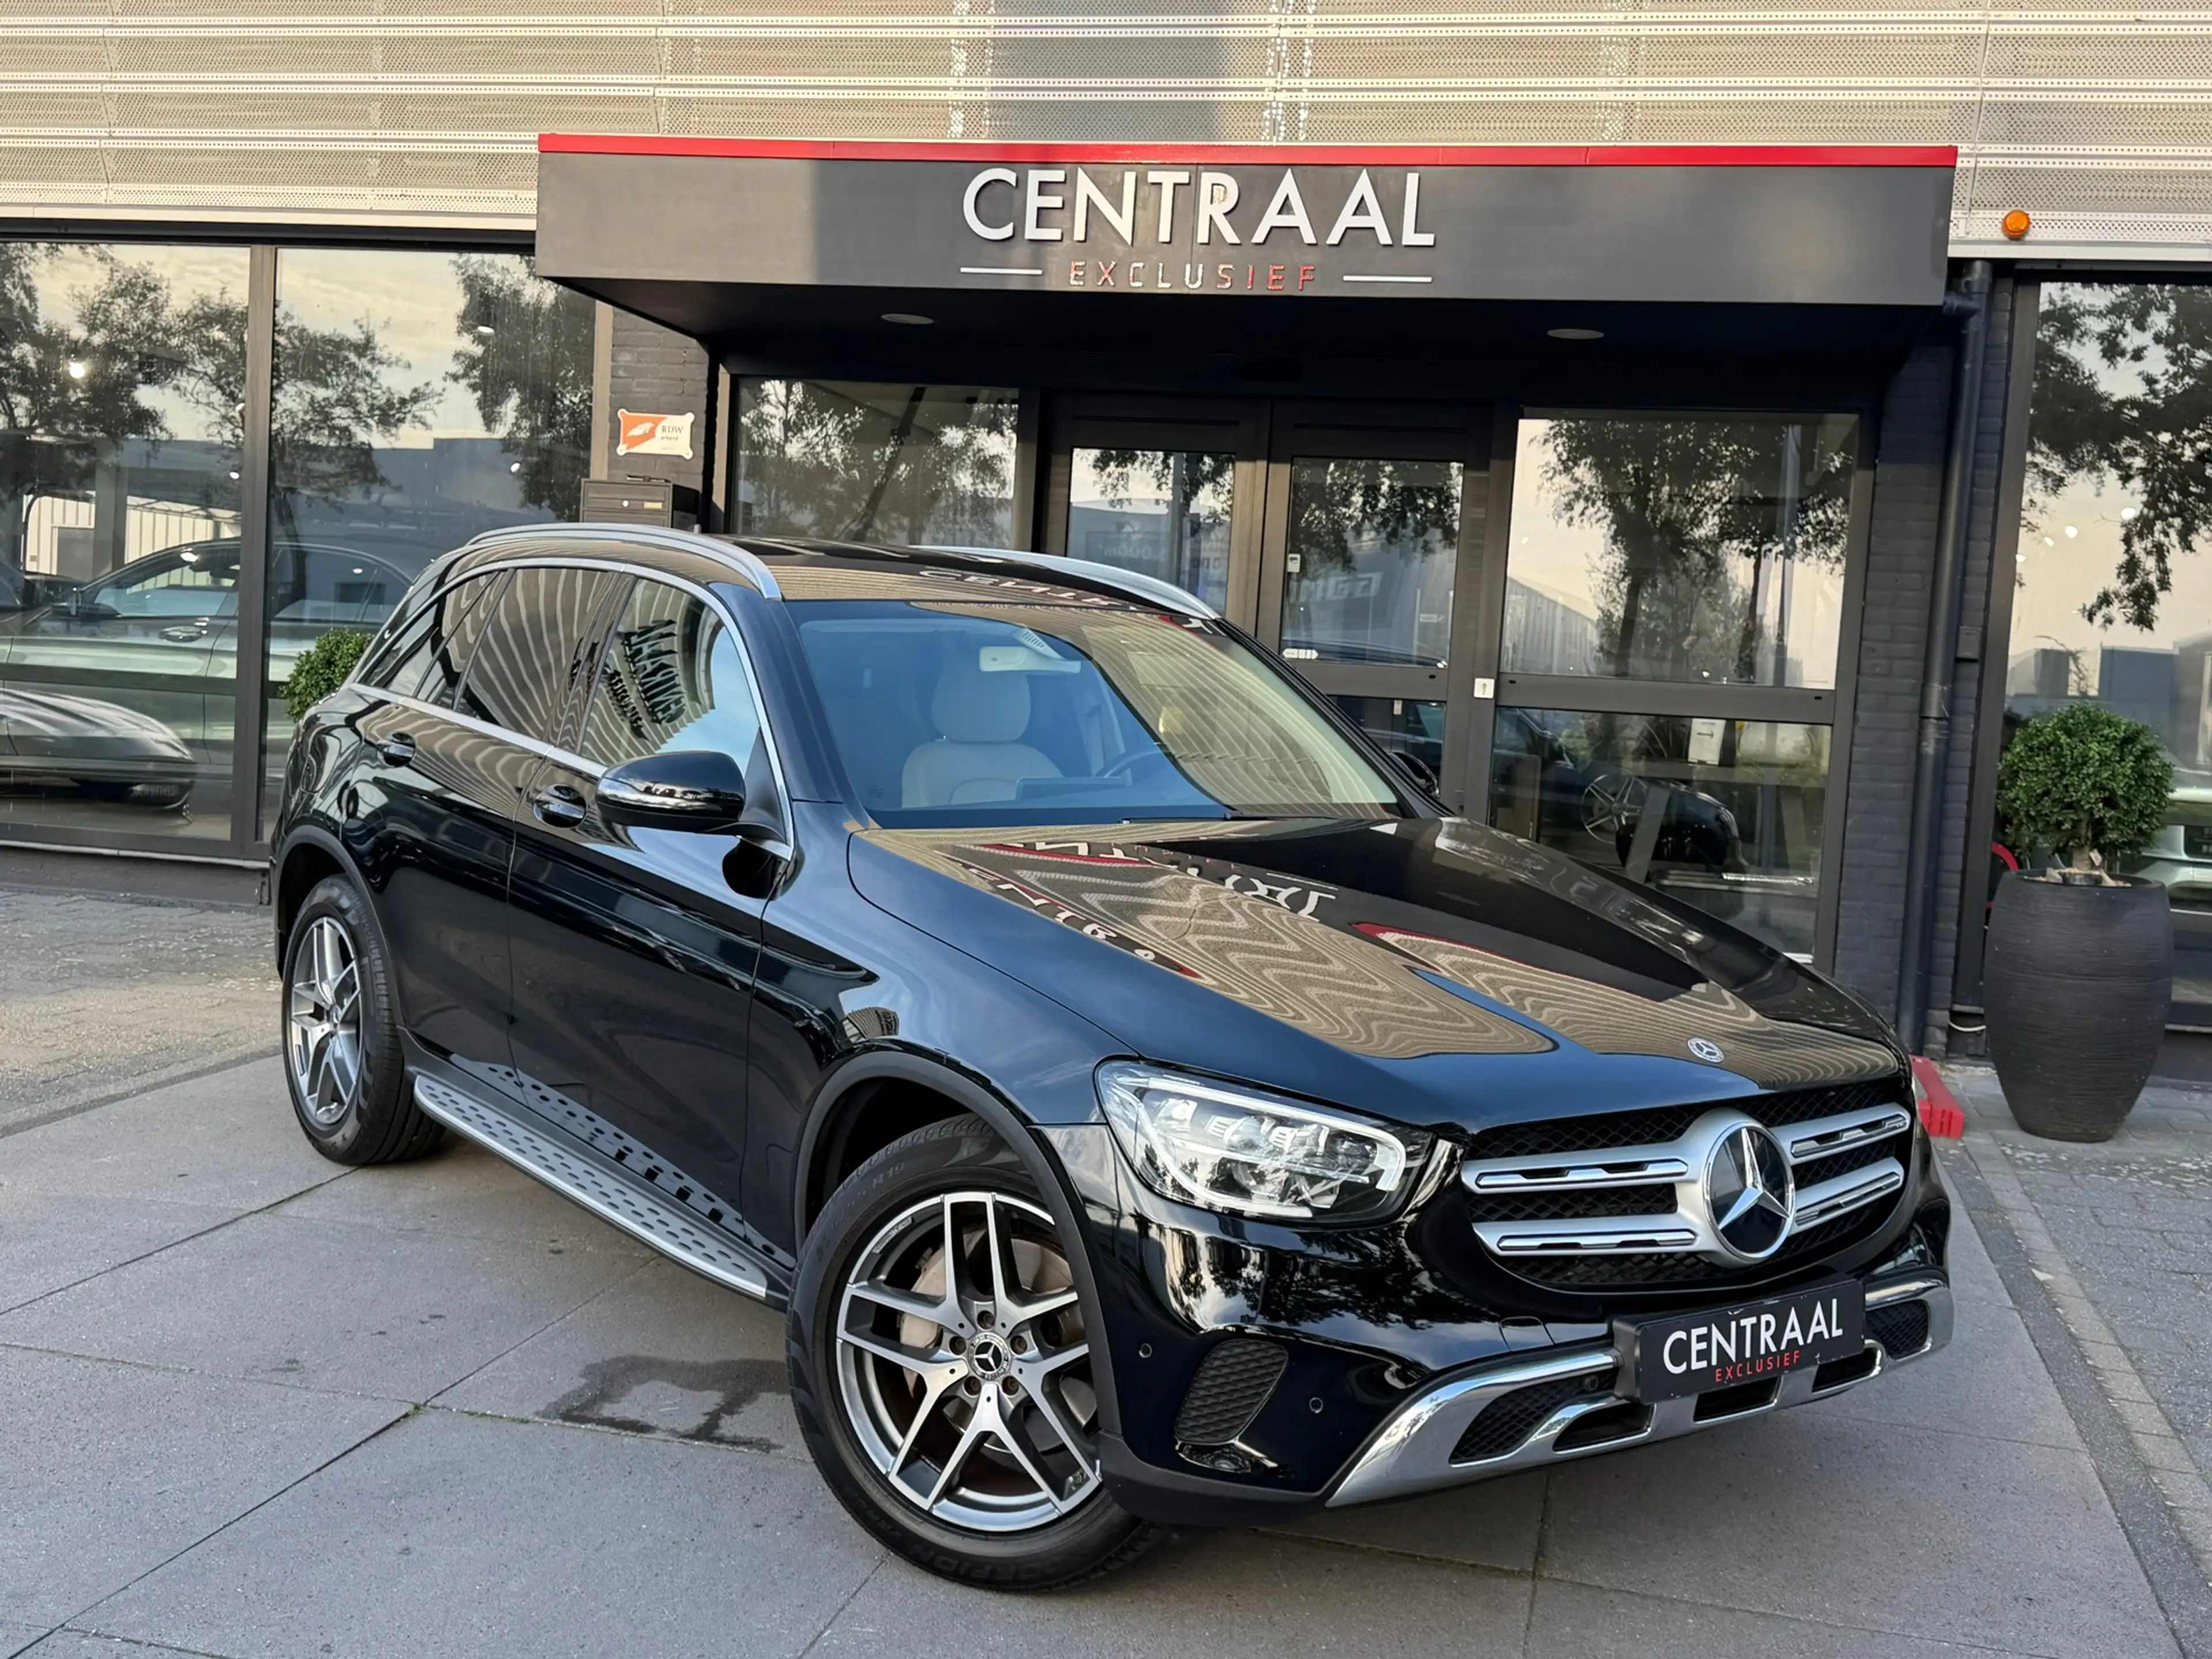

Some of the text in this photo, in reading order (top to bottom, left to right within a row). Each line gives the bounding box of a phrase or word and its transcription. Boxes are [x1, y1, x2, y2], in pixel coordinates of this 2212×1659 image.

[963, 167, 1435, 247] CENTRAAL
[1069, 260, 1316, 291] EXCLUSIEF
[661, 425, 684, 434] RDW
[1663, 1298, 1843, 1374] CENTRAAL
[1715, 1350, 1801, 1383] EXCLUSIEF
